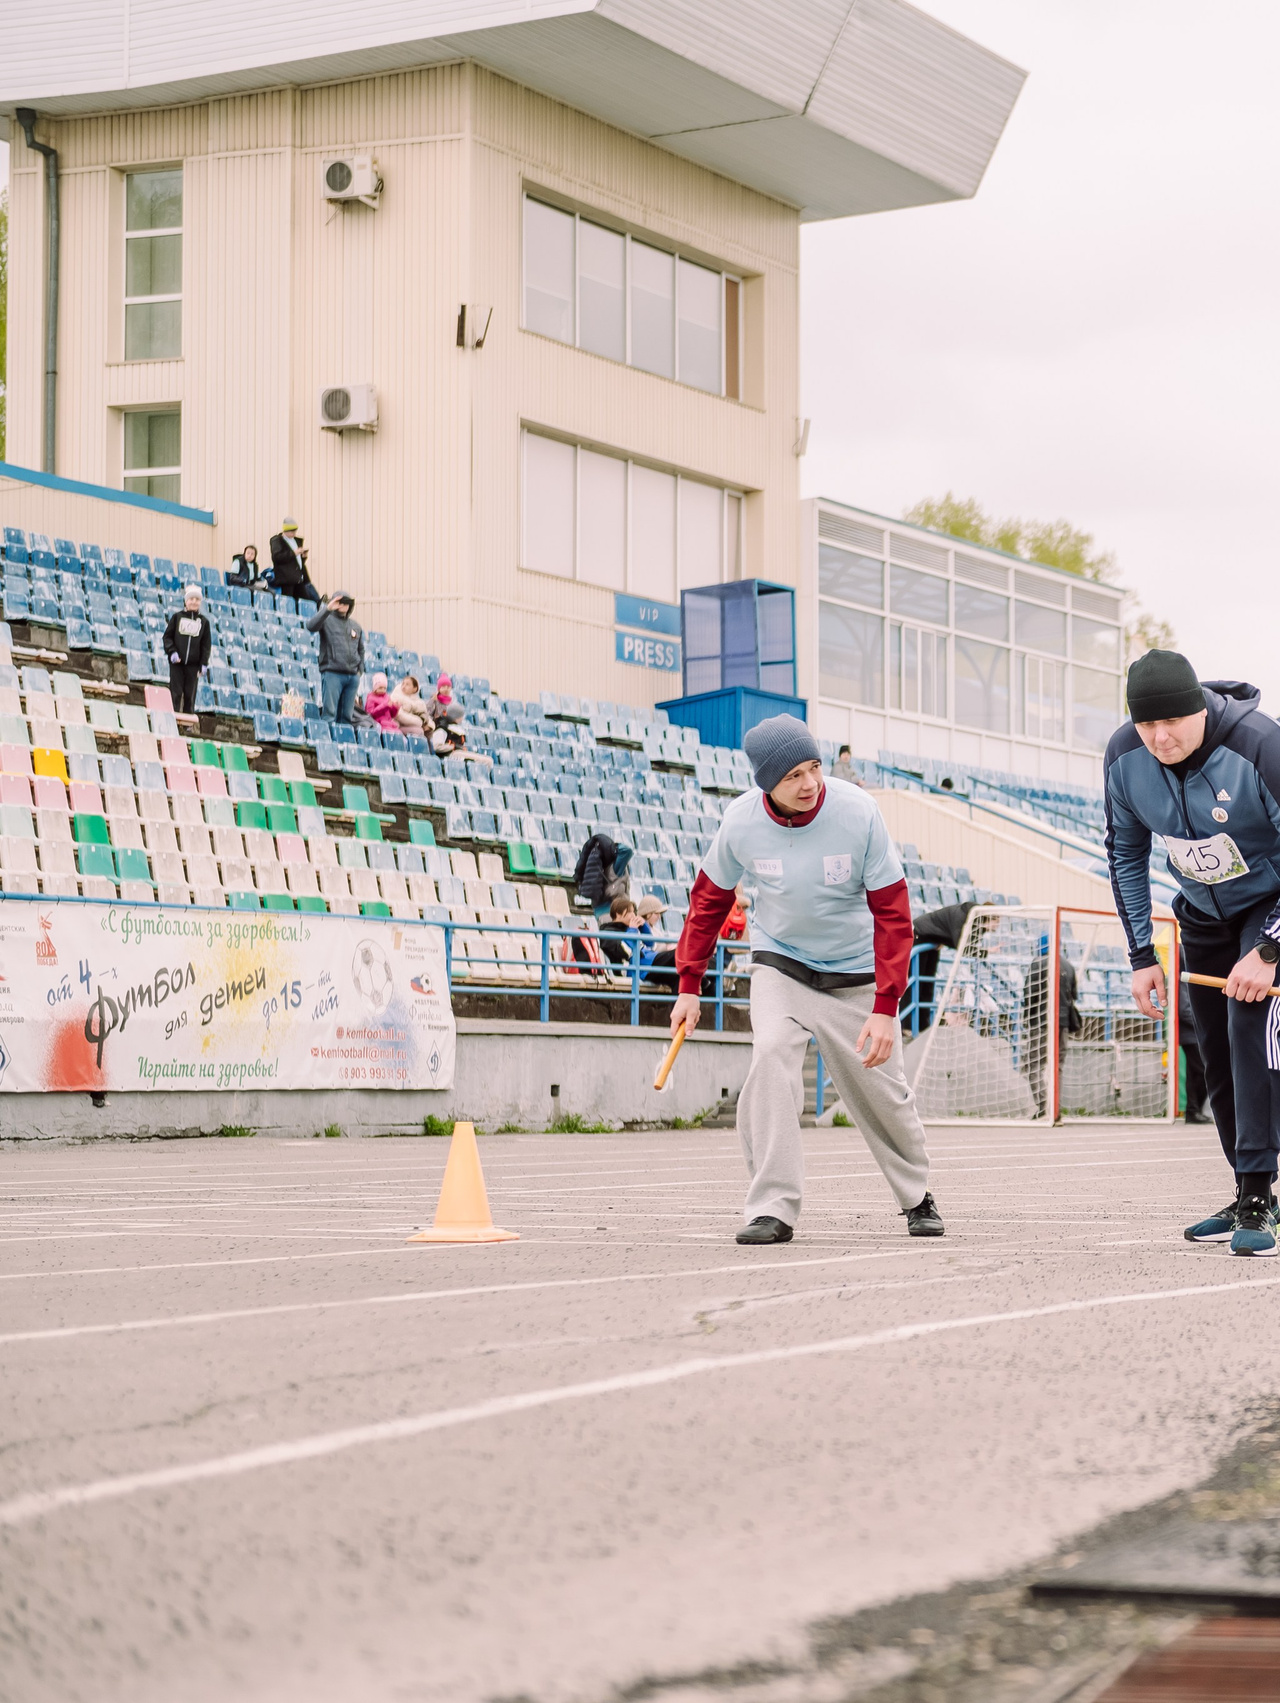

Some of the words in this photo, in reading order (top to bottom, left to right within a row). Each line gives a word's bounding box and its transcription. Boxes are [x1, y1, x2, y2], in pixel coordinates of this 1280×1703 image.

[639, 605, 659, 622] VIP
[623, 636, 675, 668] PRESS
[758, 863, 777, 871] 1019
[1186, 844, 1220, 872] 15
[120, 911, 204, 945] футболом
[206, 919, 223, 948] за
[47, 974, 74, 1006] от
[199, 966, 267, 1026] детей
[311, 986, 341, 1021] лет
[262, 997, 279, 1031] до
[137, 1056, 196, 1087] Играйте
[199, 1066, 215, 1078] на
[218, 1057, 279, 1088] здоровье!
